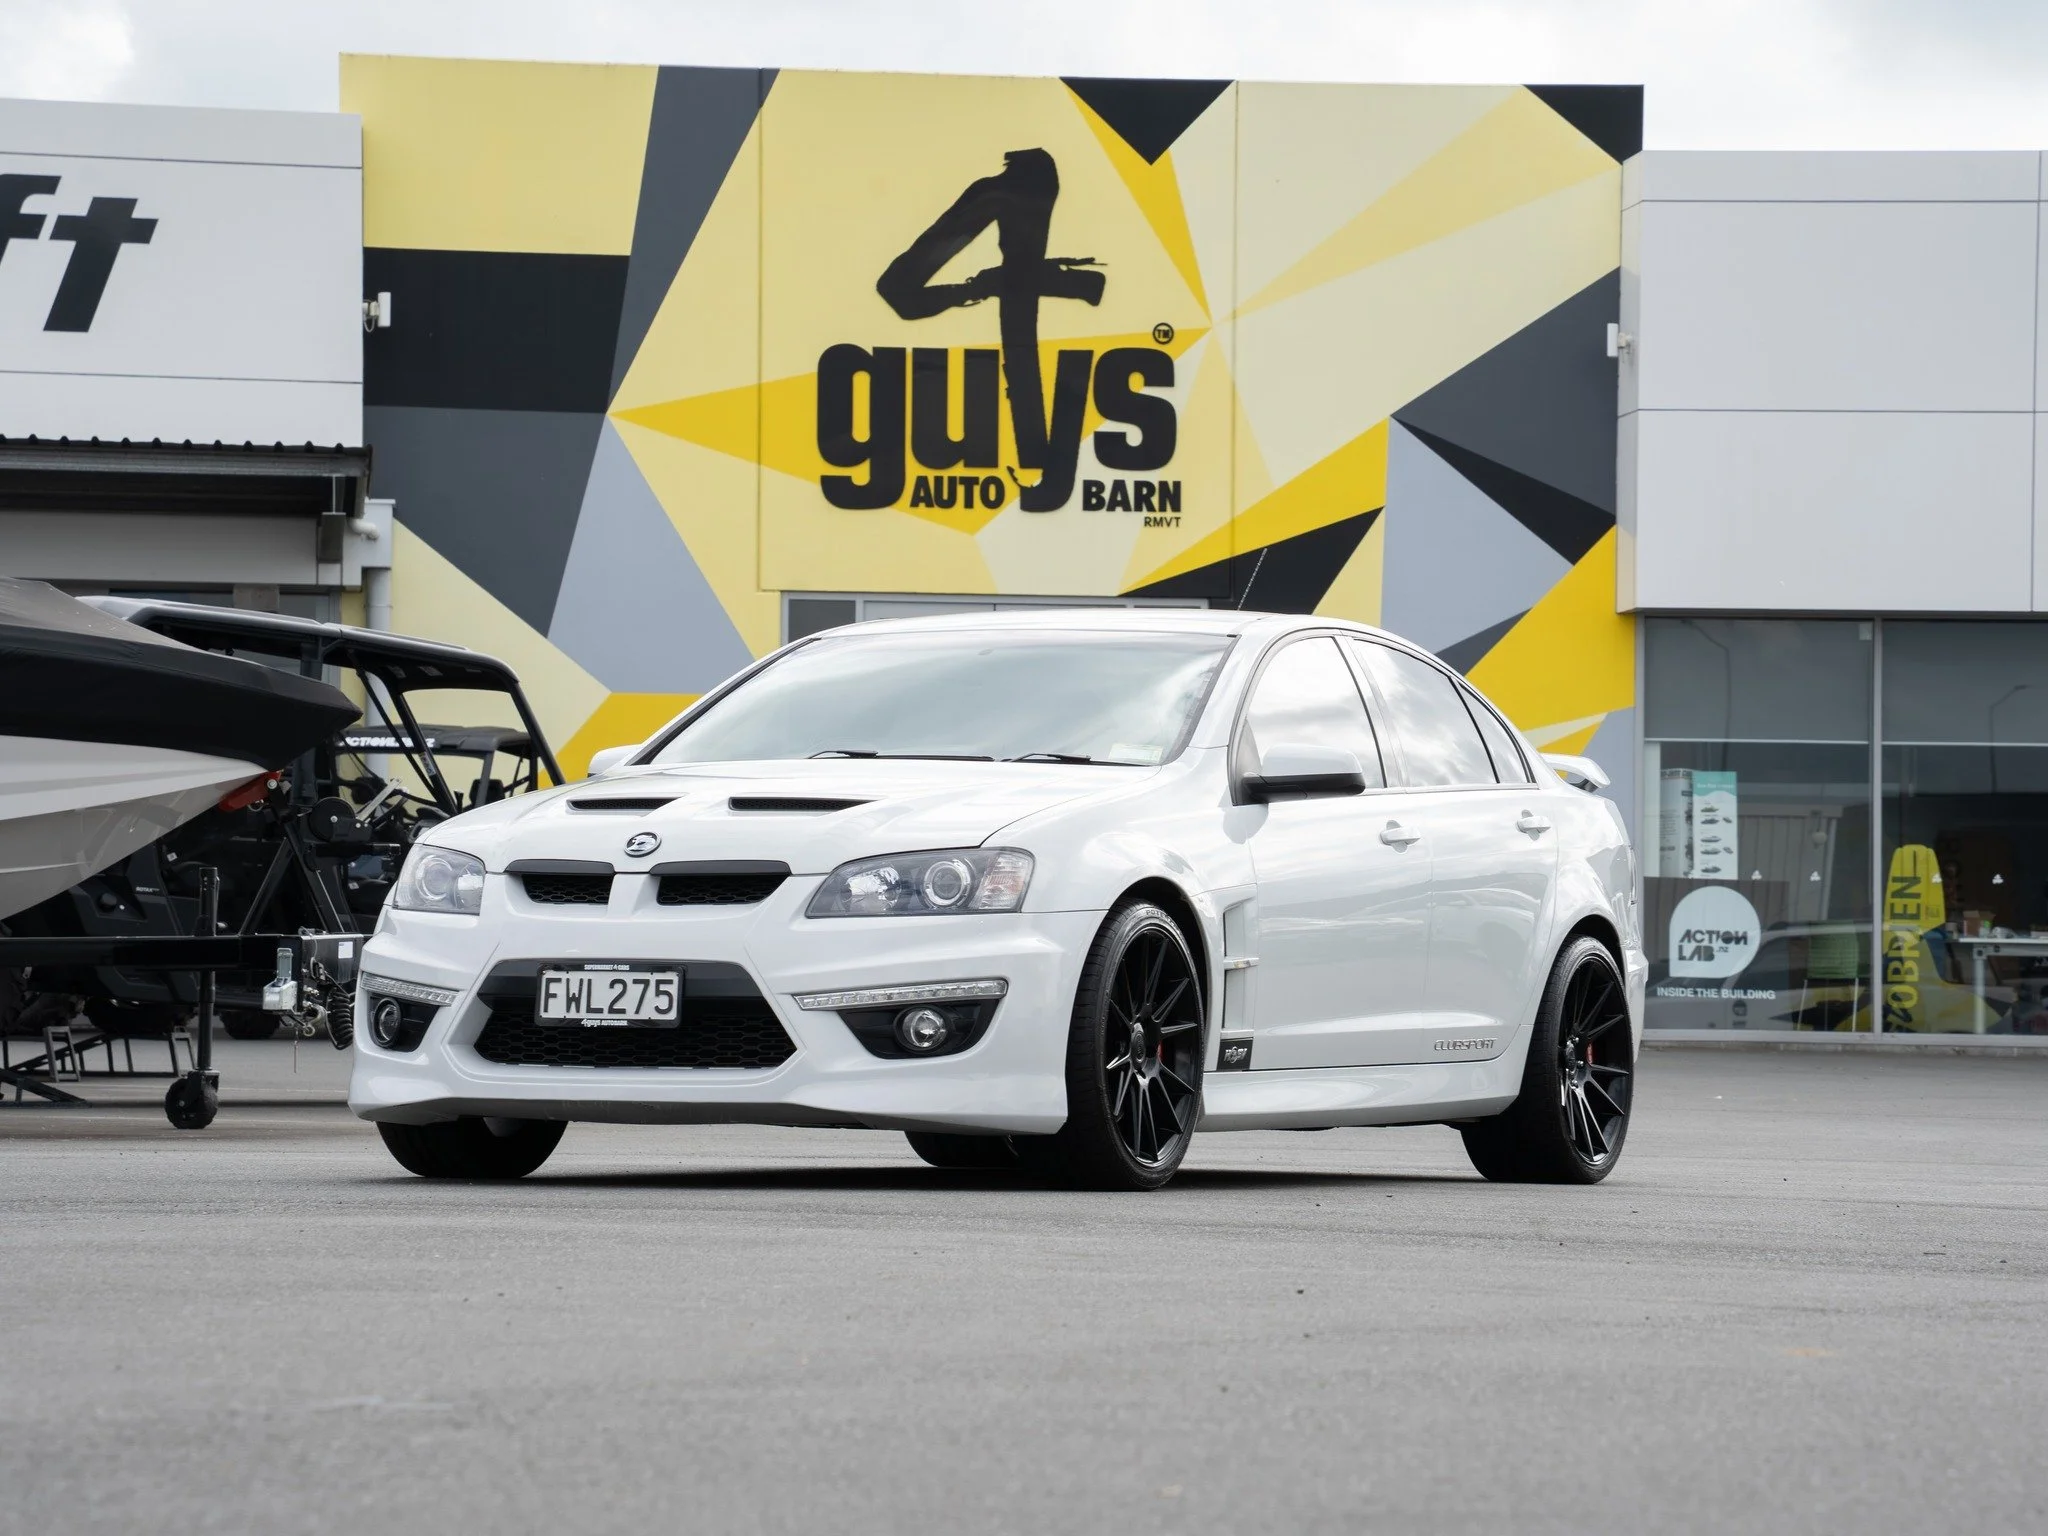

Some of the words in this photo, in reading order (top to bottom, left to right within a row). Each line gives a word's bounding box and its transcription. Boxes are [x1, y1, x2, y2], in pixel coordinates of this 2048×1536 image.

[817, 343, 1178, 513] guys
[909, 475, 1006, 510] AUTO
[1082, 479, 1182, 513] BARN
[1143, 516, 1182, 528] RMVT
[1679, 929, 1748, 945] ACTION
[543, 977, 674, 1015] FWL275
[1656, 986, 1695, 998] INSIDE
[1695, 988, 1719, 998] THE
[1721, 989, 1776, 1000] BUILDING
[1433, 1037, 1498, 1051] CLUBSPORT
